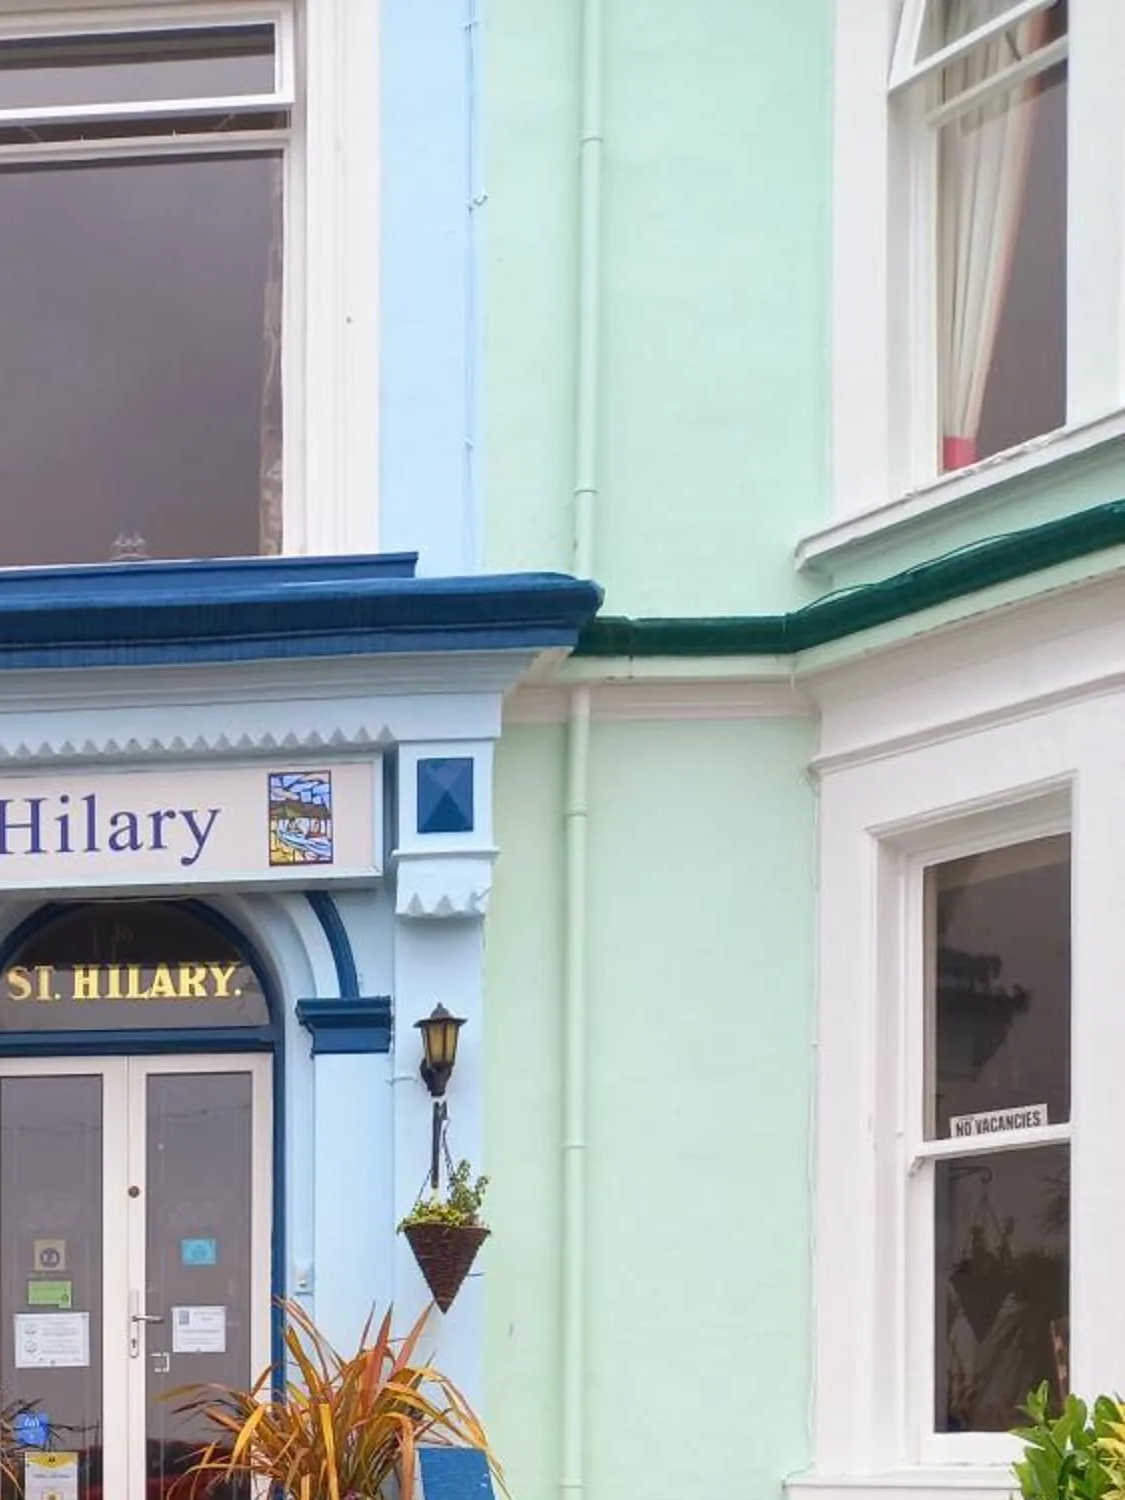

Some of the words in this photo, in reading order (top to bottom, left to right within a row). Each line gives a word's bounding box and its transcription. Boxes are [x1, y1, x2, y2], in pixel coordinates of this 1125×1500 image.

[71, 960, 242, 999] HILARY.
[955, 1119, 972, 1137] NO
[975, 1110, 1041, 1135] VACANCIES
